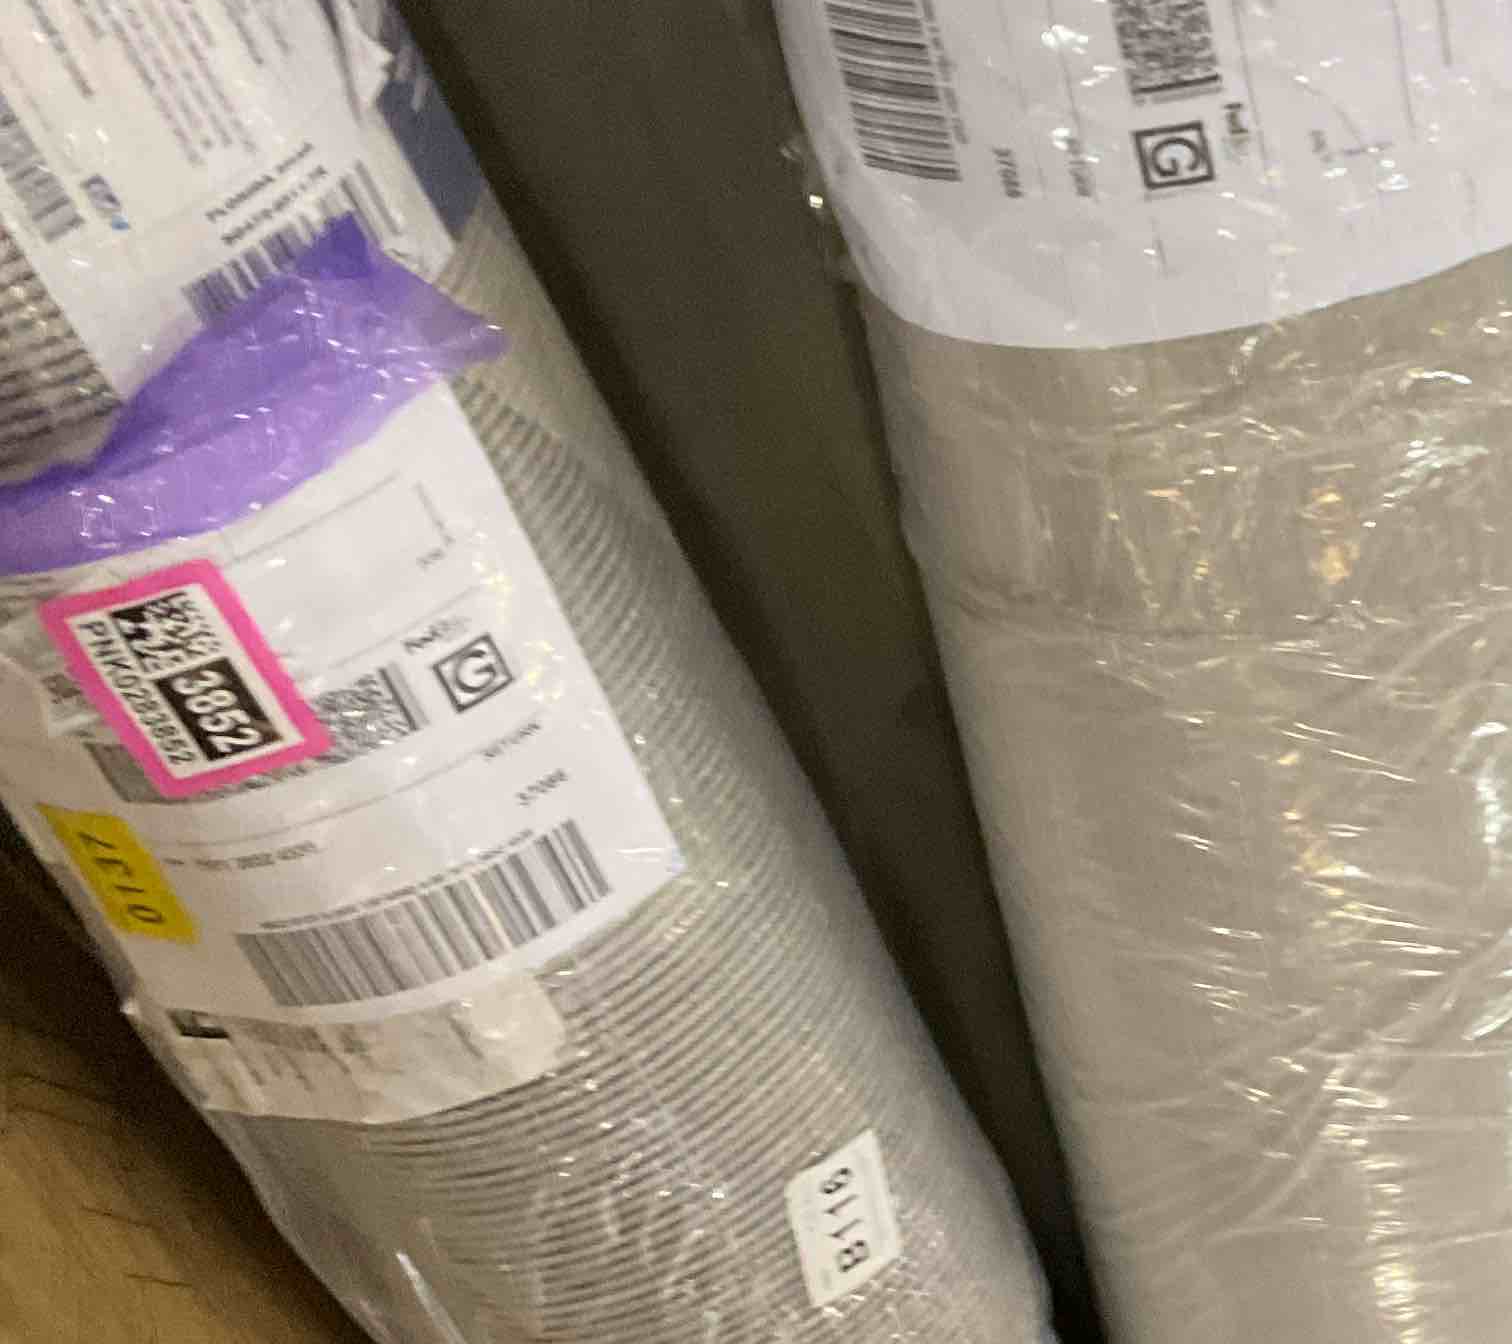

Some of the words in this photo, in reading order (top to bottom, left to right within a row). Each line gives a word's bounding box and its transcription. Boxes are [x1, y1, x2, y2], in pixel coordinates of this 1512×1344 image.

[1150, 136, 1202, 177] G
[80, 621, 200, 765] PNK0283852
[455, 647, 497, 694] G
[172, 670, 262, 753] 3852
